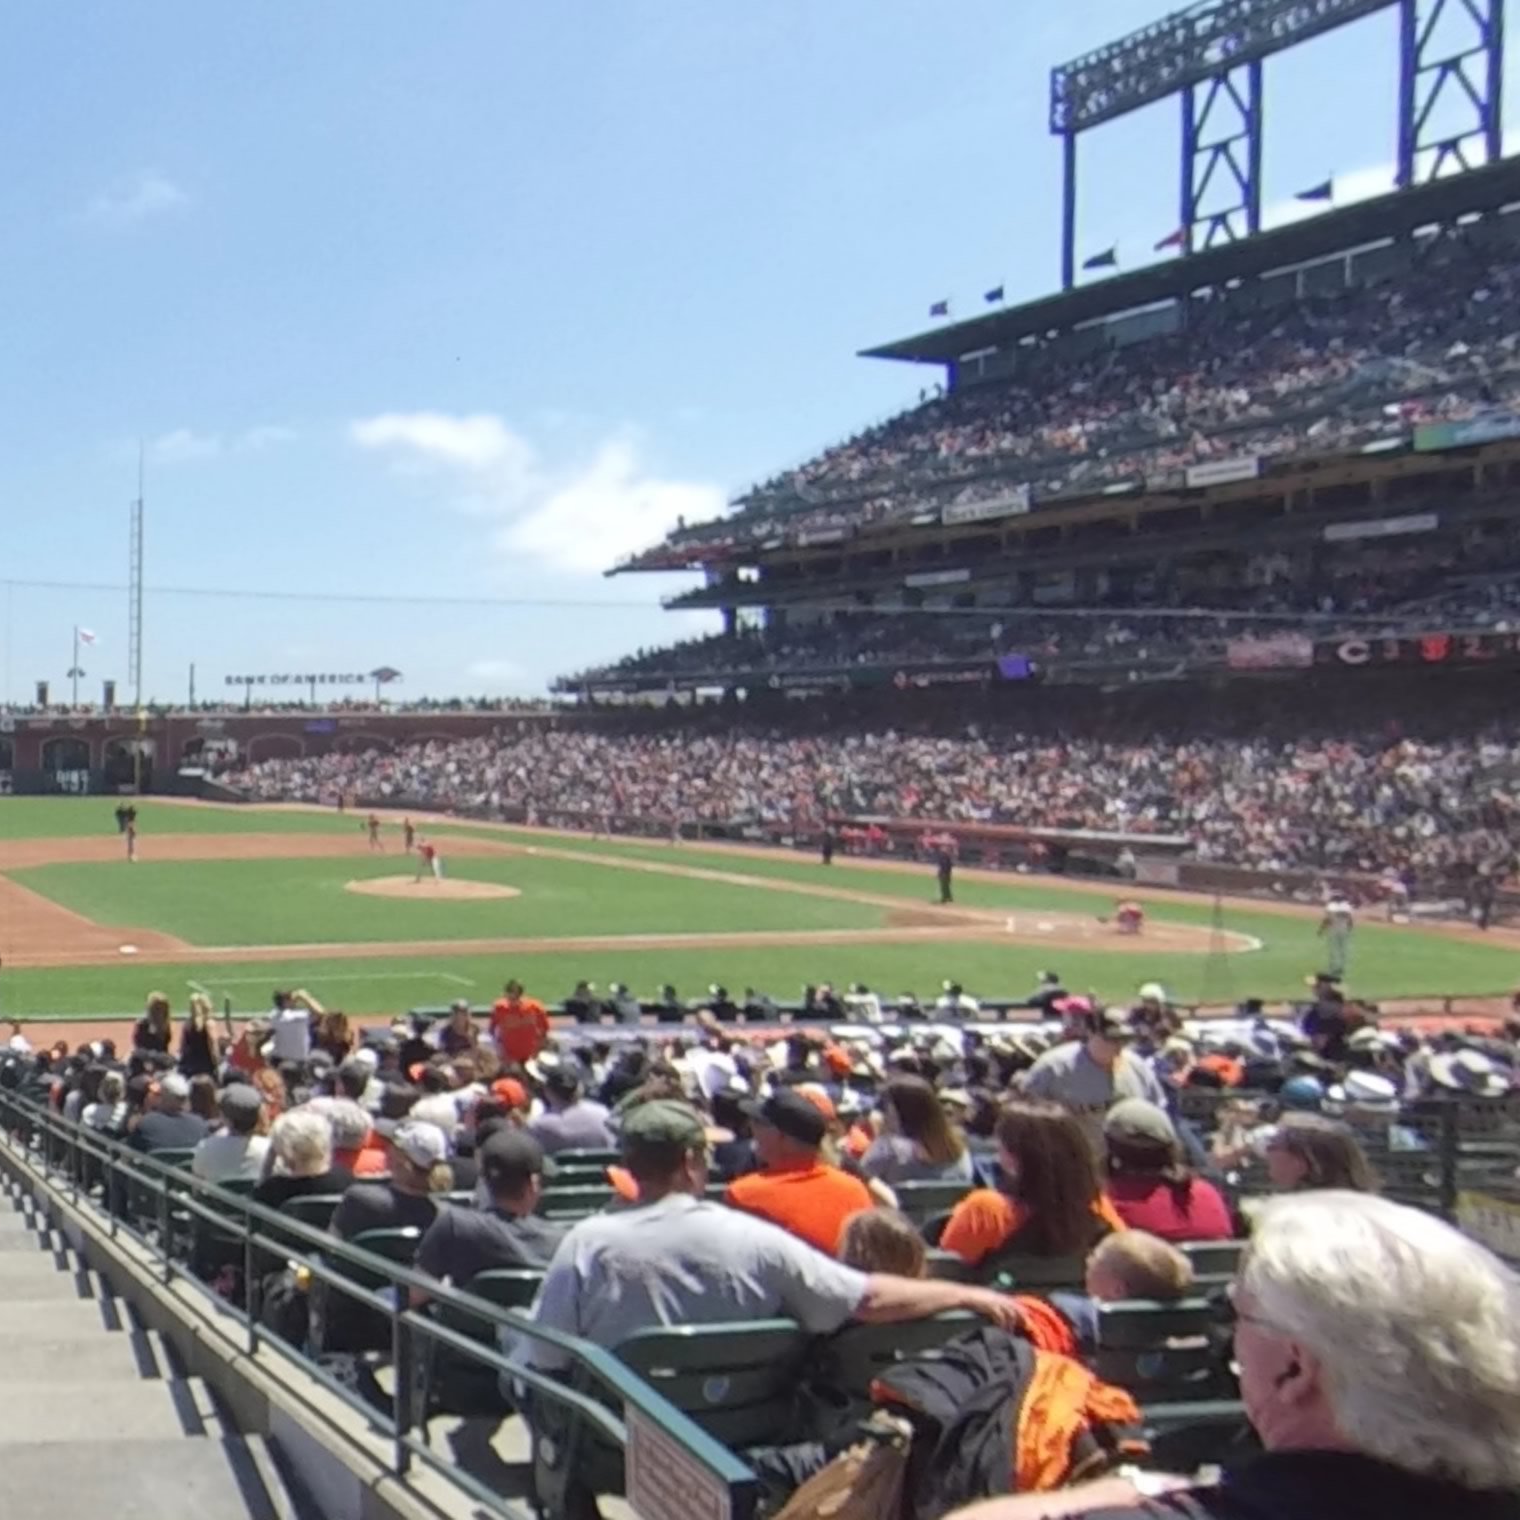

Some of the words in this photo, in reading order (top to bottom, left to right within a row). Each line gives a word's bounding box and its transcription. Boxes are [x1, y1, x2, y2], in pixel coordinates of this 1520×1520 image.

[225, 675, 265, 685] BANK
[270, 675, 289, 684] OF
[294, 674, 365, 684] AMERICA
